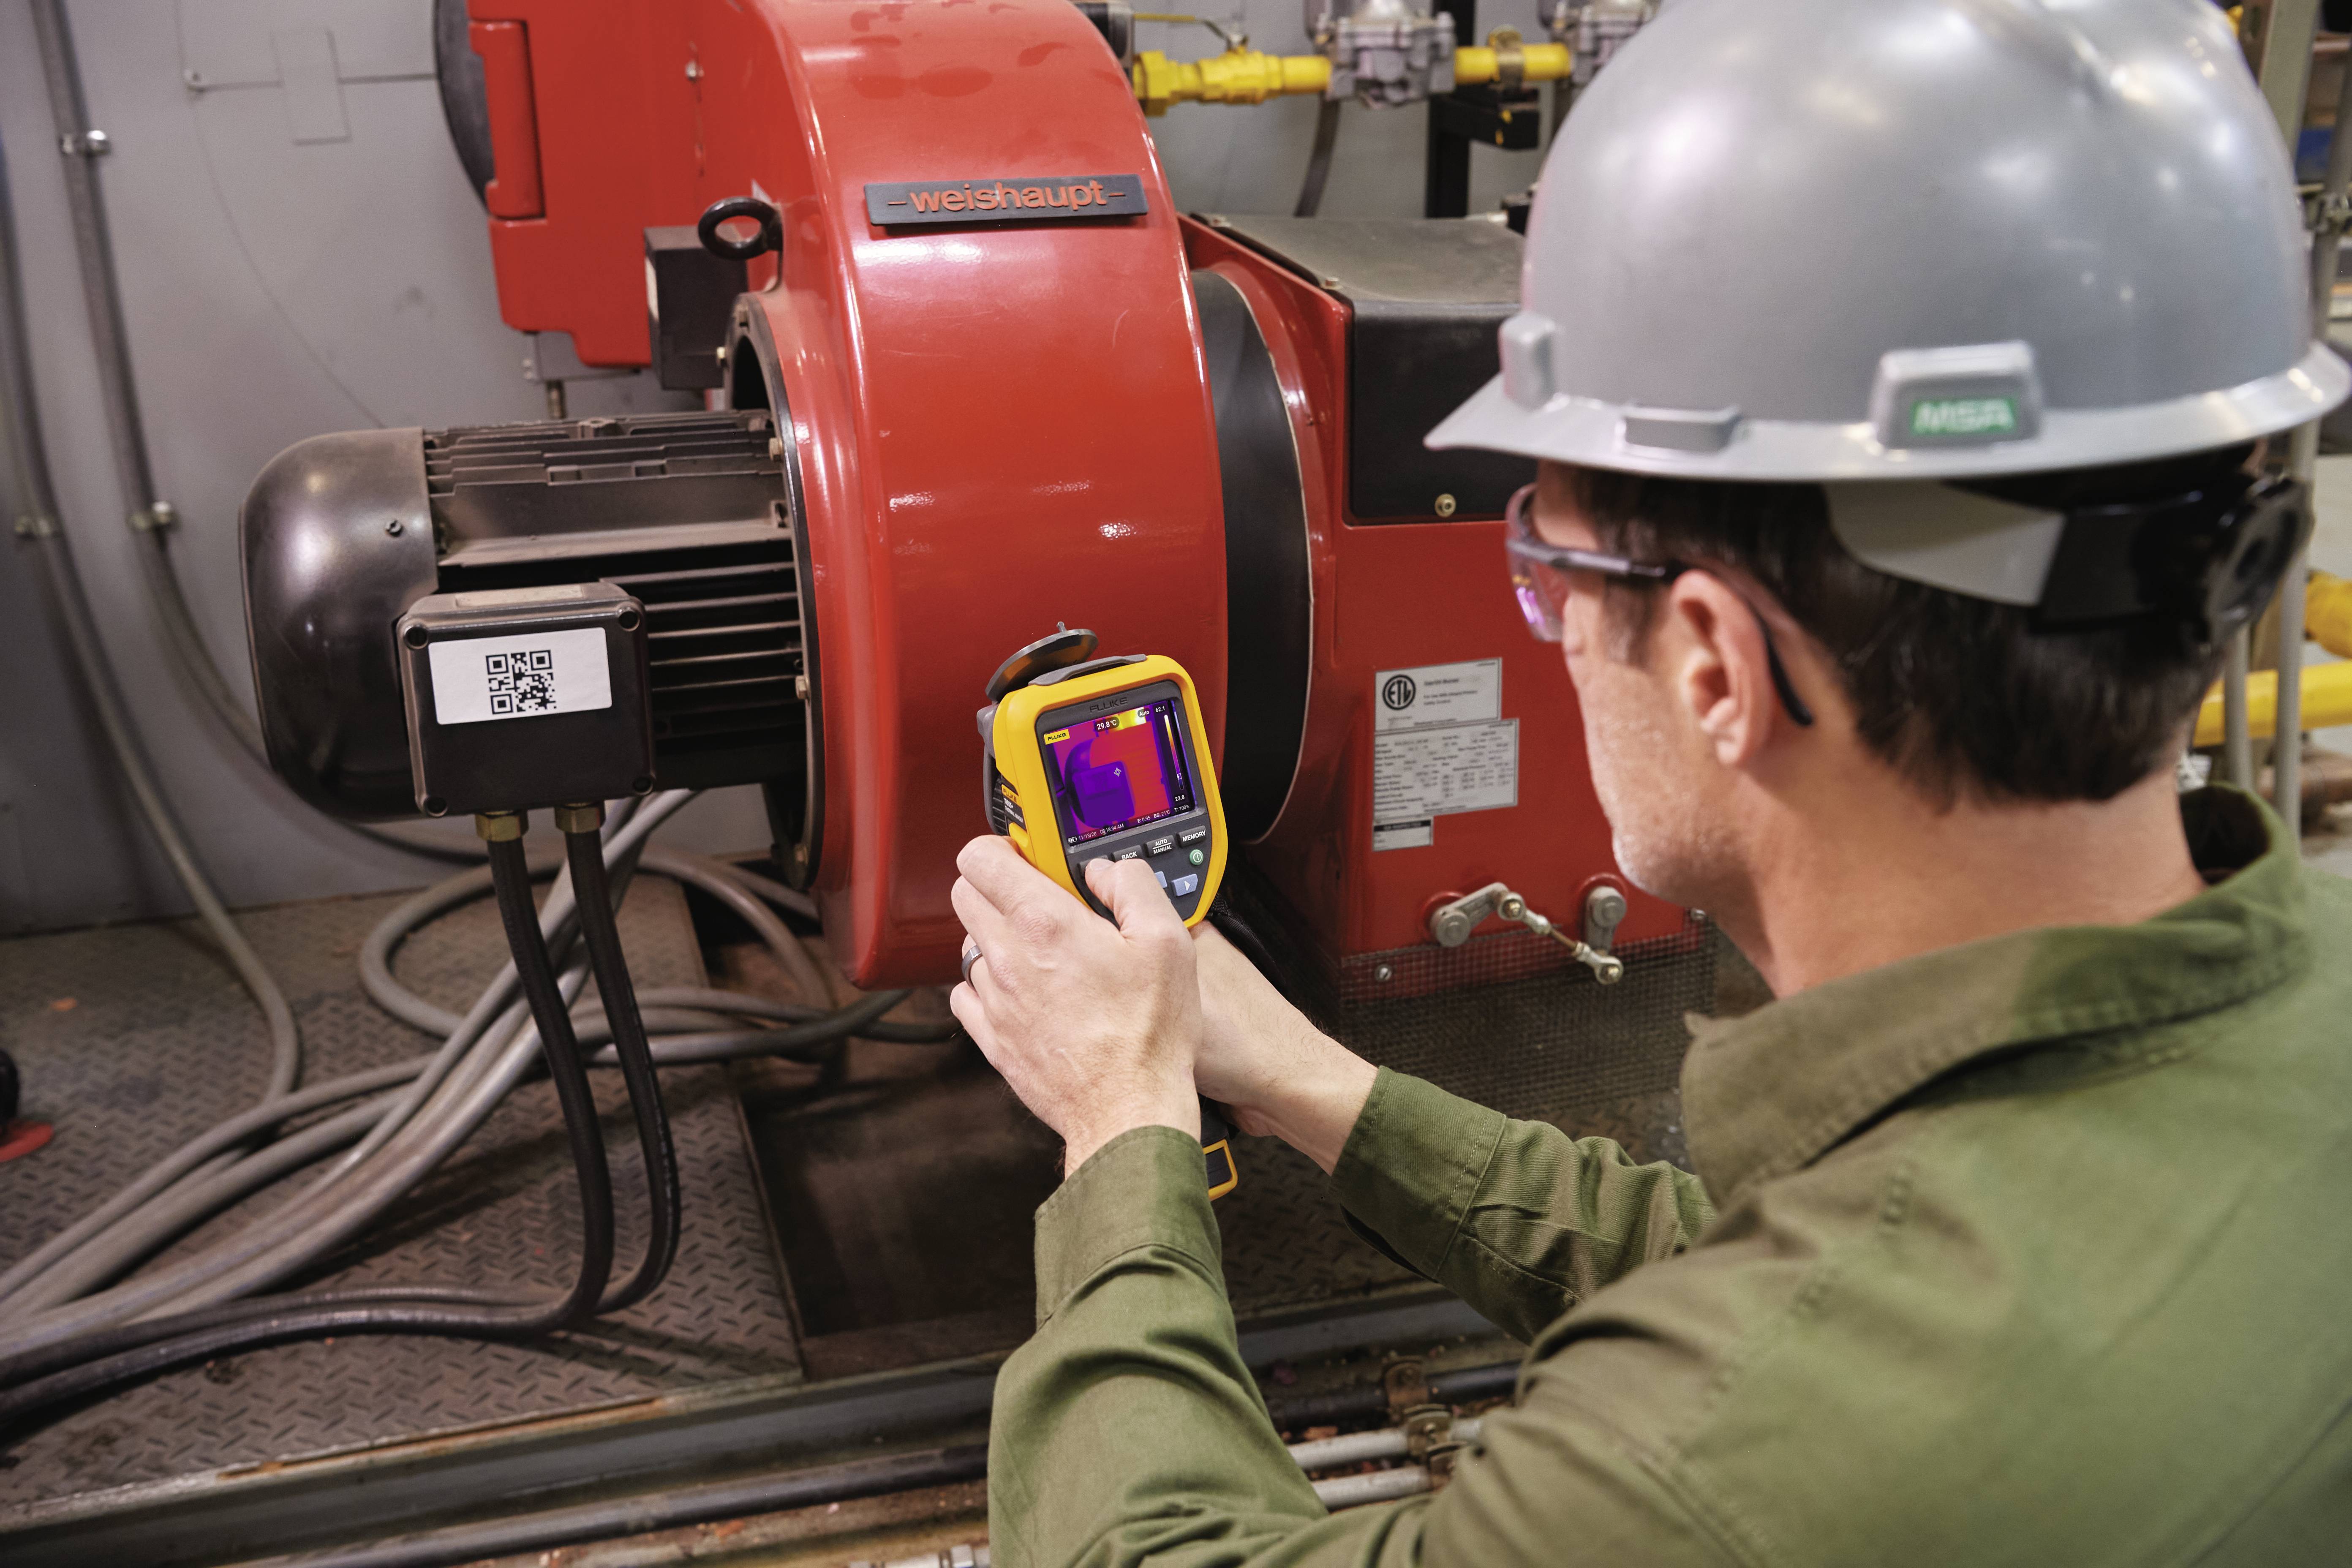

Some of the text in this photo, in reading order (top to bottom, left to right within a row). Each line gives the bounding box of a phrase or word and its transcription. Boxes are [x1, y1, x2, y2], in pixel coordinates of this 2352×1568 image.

[1089, 697, 1128, 713] FLUKE
[1078, 831, 1097, 840] 11/13/20
[1100, 825, 1117, 834] 08:18:34
[1182, 830, 1206, 842] MEMORY
[1155, 838, 1168, 847] AUTO
[1153, 845, 1172, 854] MANUAL
[1122, 851, 1138, 860] BACK
